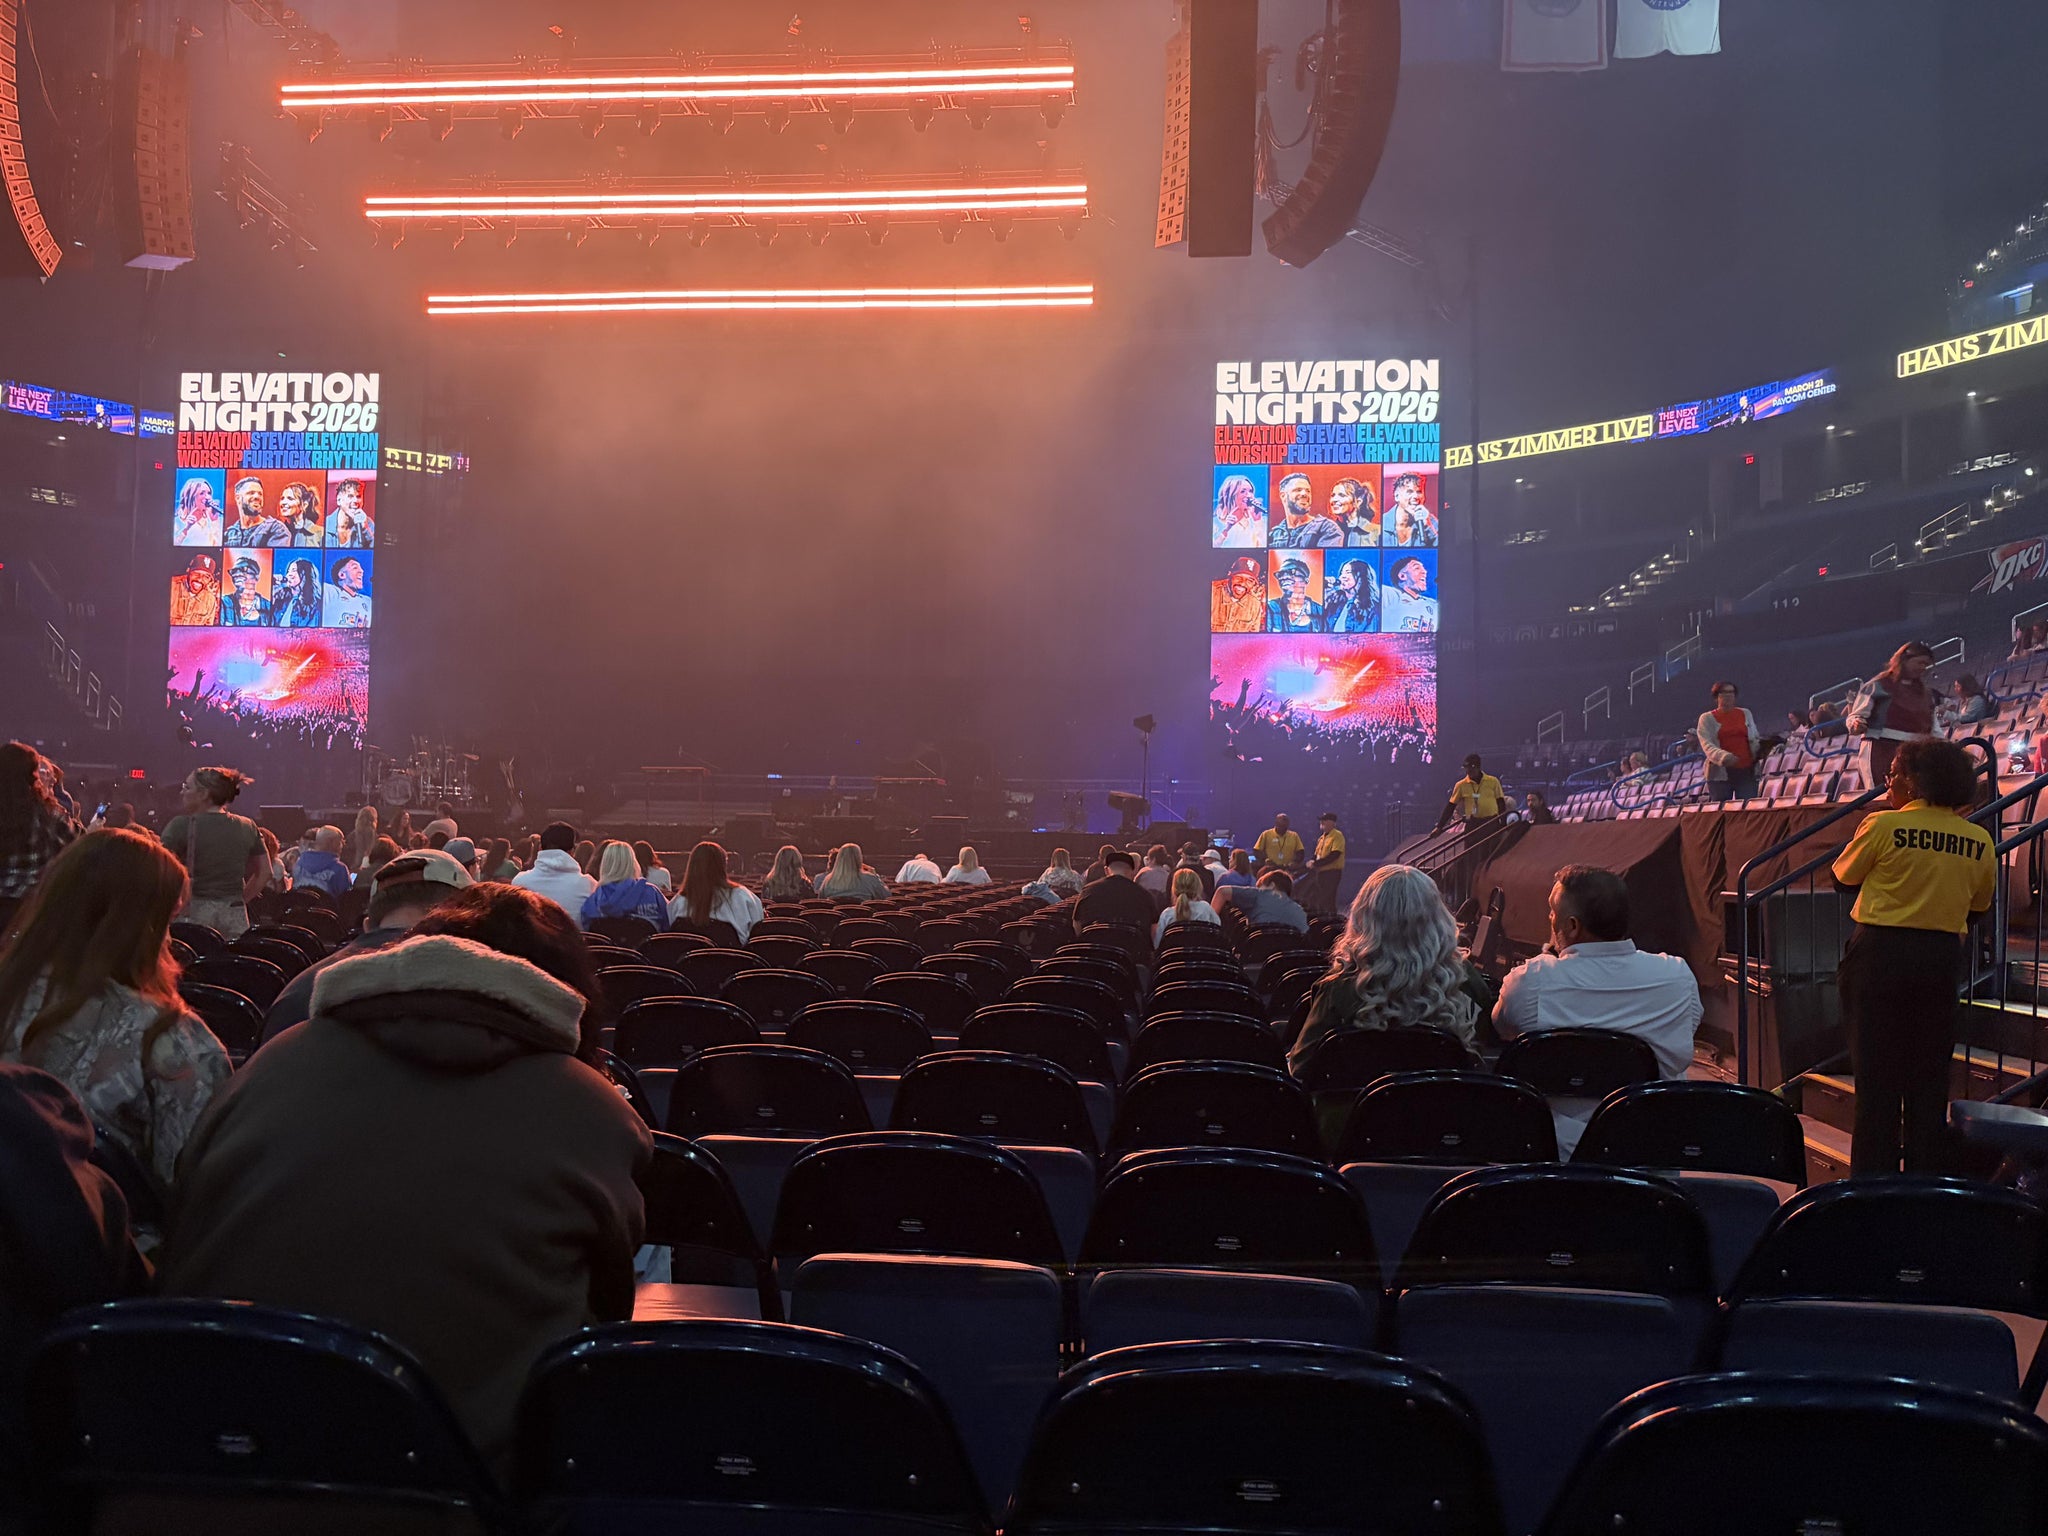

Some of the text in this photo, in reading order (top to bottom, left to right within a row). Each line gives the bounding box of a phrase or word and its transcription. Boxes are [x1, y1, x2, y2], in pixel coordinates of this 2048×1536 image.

[1903, 336, 1980, 375] HANS
[180, 372, 380, 402] ELEVATION
[1216, 359, 1440, 393] ELEVATION
[8, 395, 52, 414] LEVEL
[9, 385, 52, 402] THE NEXT
[179, 402, 379, 432] NIGHTS 2026
[1215, 391, 1440, 425] NIGHTS 2026
[1658, 406, 1700, 421] THE NEXT
[1214, 422, 1440, 445] ELEVATION STEVEN ELEVATION
[1658, 416, 1700, 435] LEVEL
[177, 432, 379, 450] ELEVATION STEVEN ELEVATION
[1214, 442, 1440, 464] WORSHIP FURTICK RHYTHM
[1446, 417, 1650, 467] HANS ZIMMER LIVE
[177, 450, 243, 468] WORSHIP
[242, 450, 311, 469] FURTICK
[311, 450, 378, 469] RHYTHM
[1991, 542, 2042, 593] OKC
[1893, 828, 1986, 861] SECURITY
